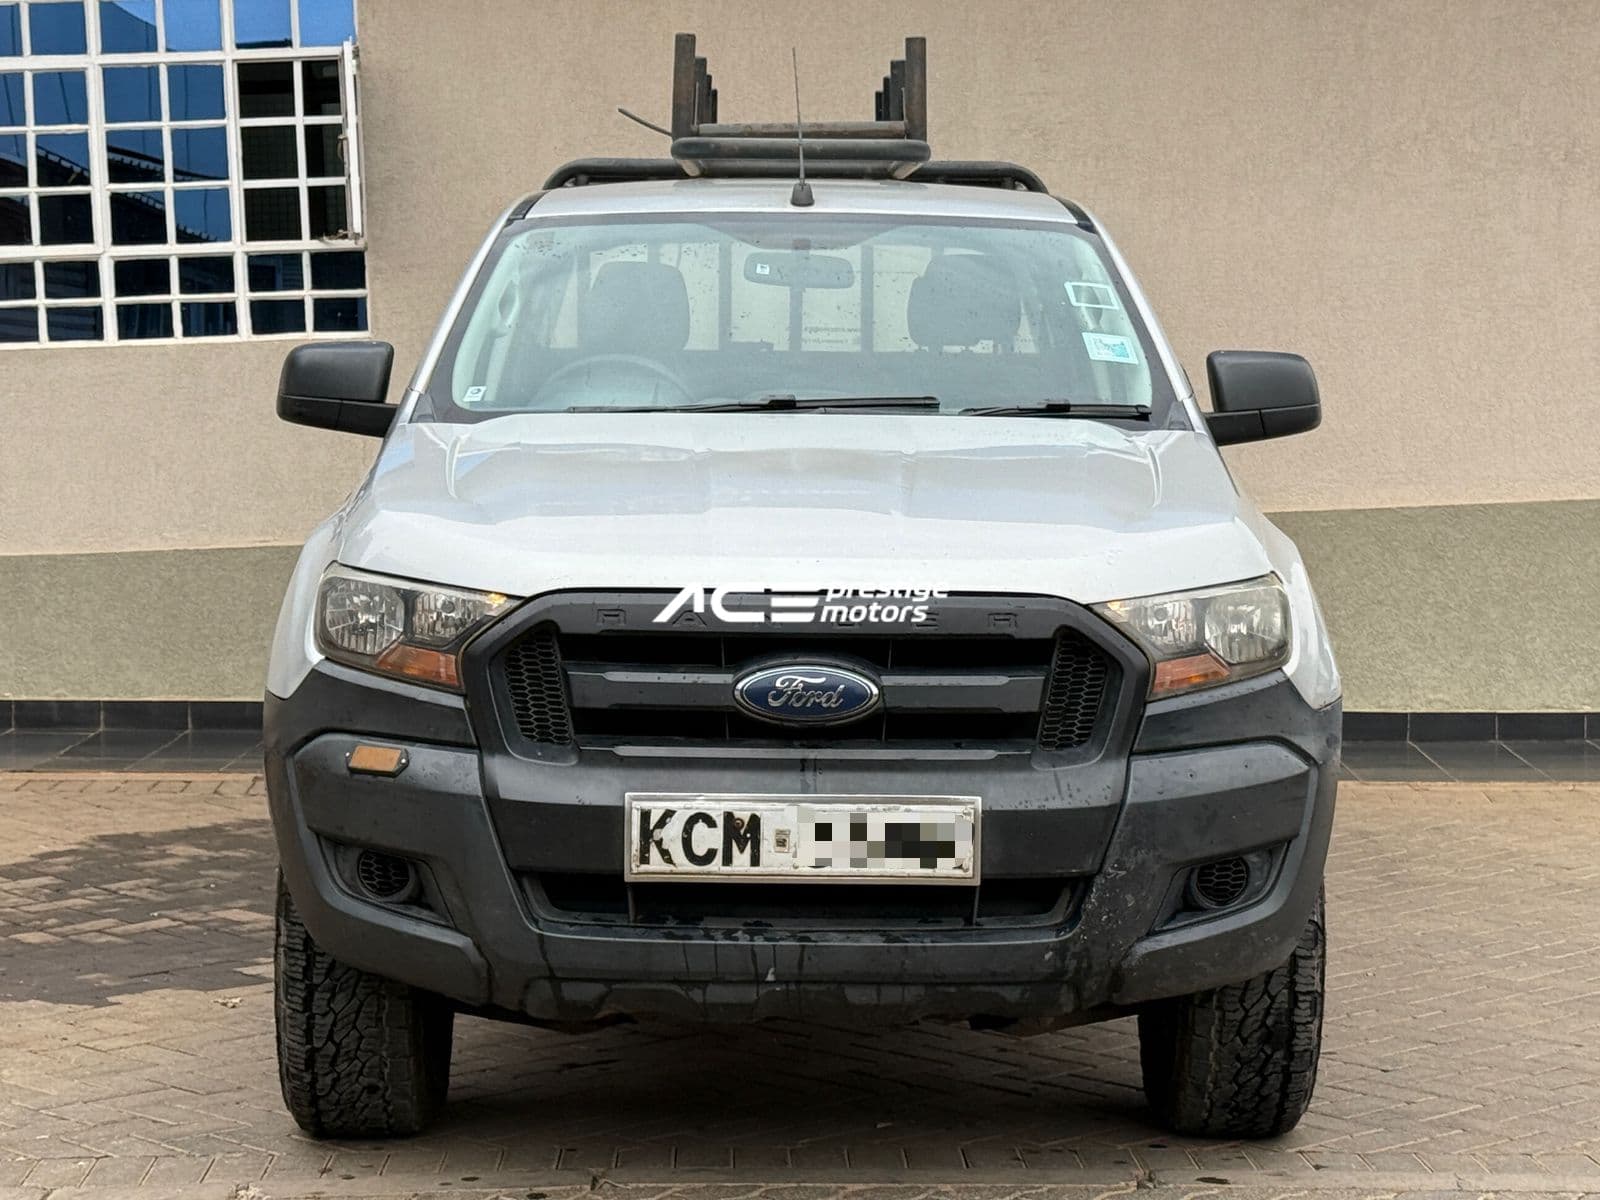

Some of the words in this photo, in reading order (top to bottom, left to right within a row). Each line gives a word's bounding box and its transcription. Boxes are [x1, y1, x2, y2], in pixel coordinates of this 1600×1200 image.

[597, 607, 1019, 630] RAER
[767, 675, 845, 708] Ford
[639, 808, 762, 868] KCM
